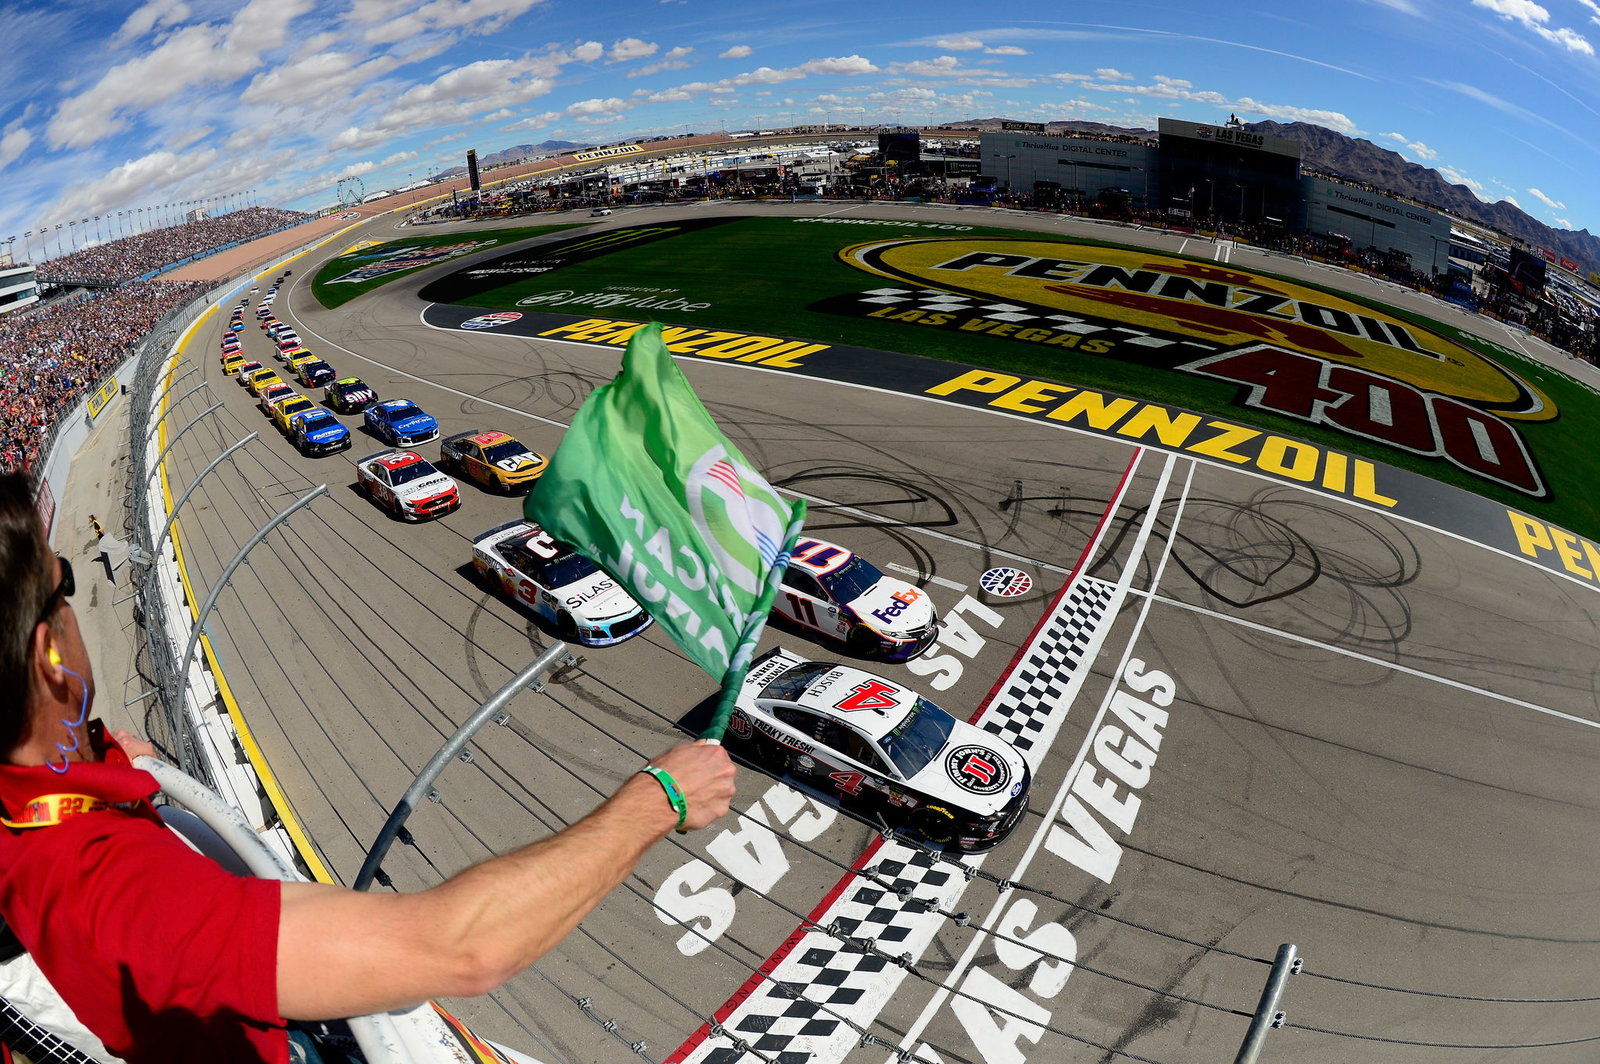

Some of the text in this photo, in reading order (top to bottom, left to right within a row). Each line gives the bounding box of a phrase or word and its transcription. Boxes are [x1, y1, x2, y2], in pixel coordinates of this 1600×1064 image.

[578, 145, 638, 161] PENNZOIL
[1063, 144, 1093, 154] DIGITAL
[1095, 149, 1128, 157] CENTER
[1216, 129, 1233, 139] LAS
[1235, 132, 1264, 146] VEGAS
[1376, 202, 1404, 216] DIGITAL
[1406, 212, 1432, 225] CENTER
[929, 250, 1446, 362] PENNZOIL
[867, 306, 1116, 354] LAS VEGAS
[345, 389, 373, 403] ally
[1174, 343, 1546, 498] 400
[924, 368, 1399, 508] PENNZOIL
[496, 451, 542, 472] CAT
[377, 483, 389, 500] 38
[518, 580, 537, 605] 3
[566, 578, 614, 609] SiLAS
[871, 588, 923, 625] FedEx
[785, 592, 820, 628] 11
[906, 594, 1005, 691] LAS
[745, 656, 779, 685] JOHN'S
[757, 662, 789, 689] JIMMY
[807, 670, 845, 698] BUSCH
[832, 678, 901, 713] 4
[753, 718, 816, 755] FREAKY FRESH!
[955, 748, 985, 760] JOHN'S
[961, 753, 997, 786] JJ
[828, 771, 867, 796] 4
[950, 757, 968, 784] JIMMY
[1044, 657, 1176, 885] VEGAS
[653, 782, 838, 957] GAS
[726, 935, 799, 1010] WINNING
[913, 898, 1078, 1064] AS
